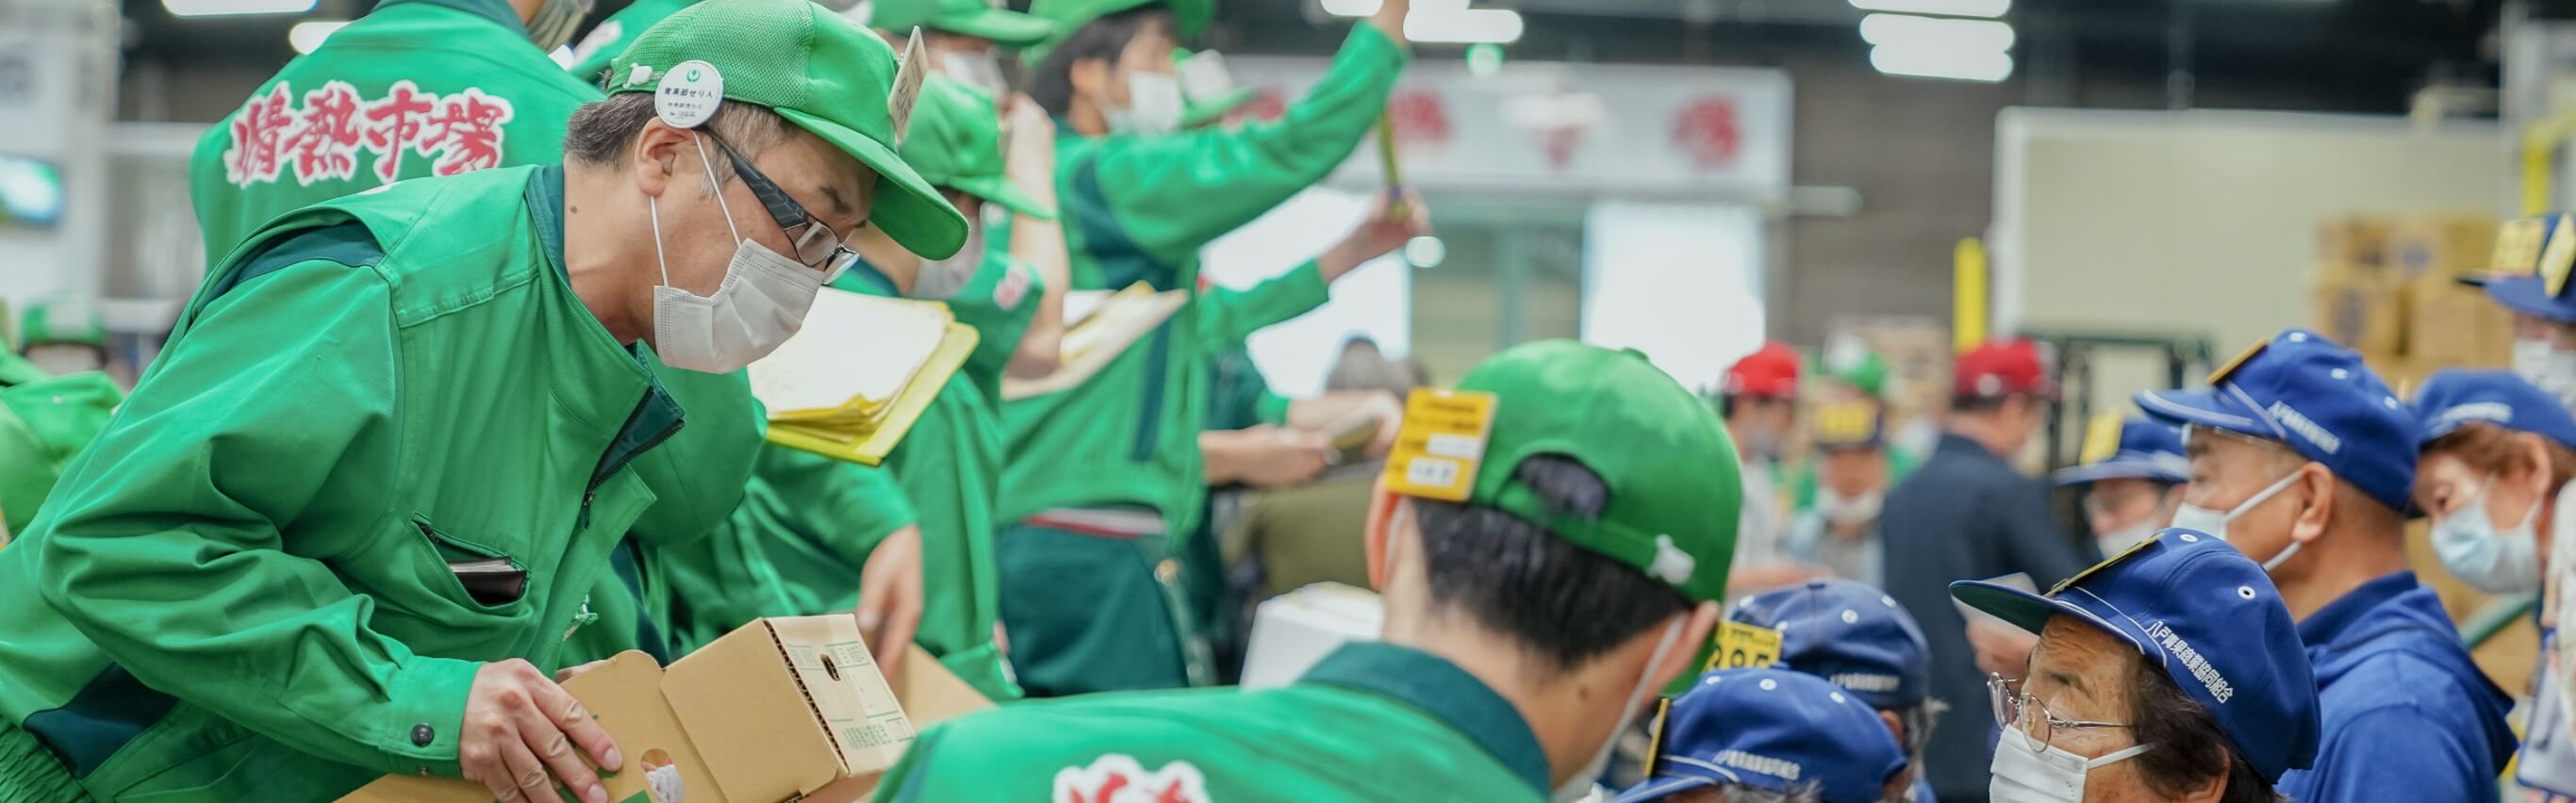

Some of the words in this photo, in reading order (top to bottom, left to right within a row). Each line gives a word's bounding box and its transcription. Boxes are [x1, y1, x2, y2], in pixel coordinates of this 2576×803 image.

[225, 82, 510, 183] 情熱市場
[2145, 620, 2234, 704] 八戸青果商業協同組合
